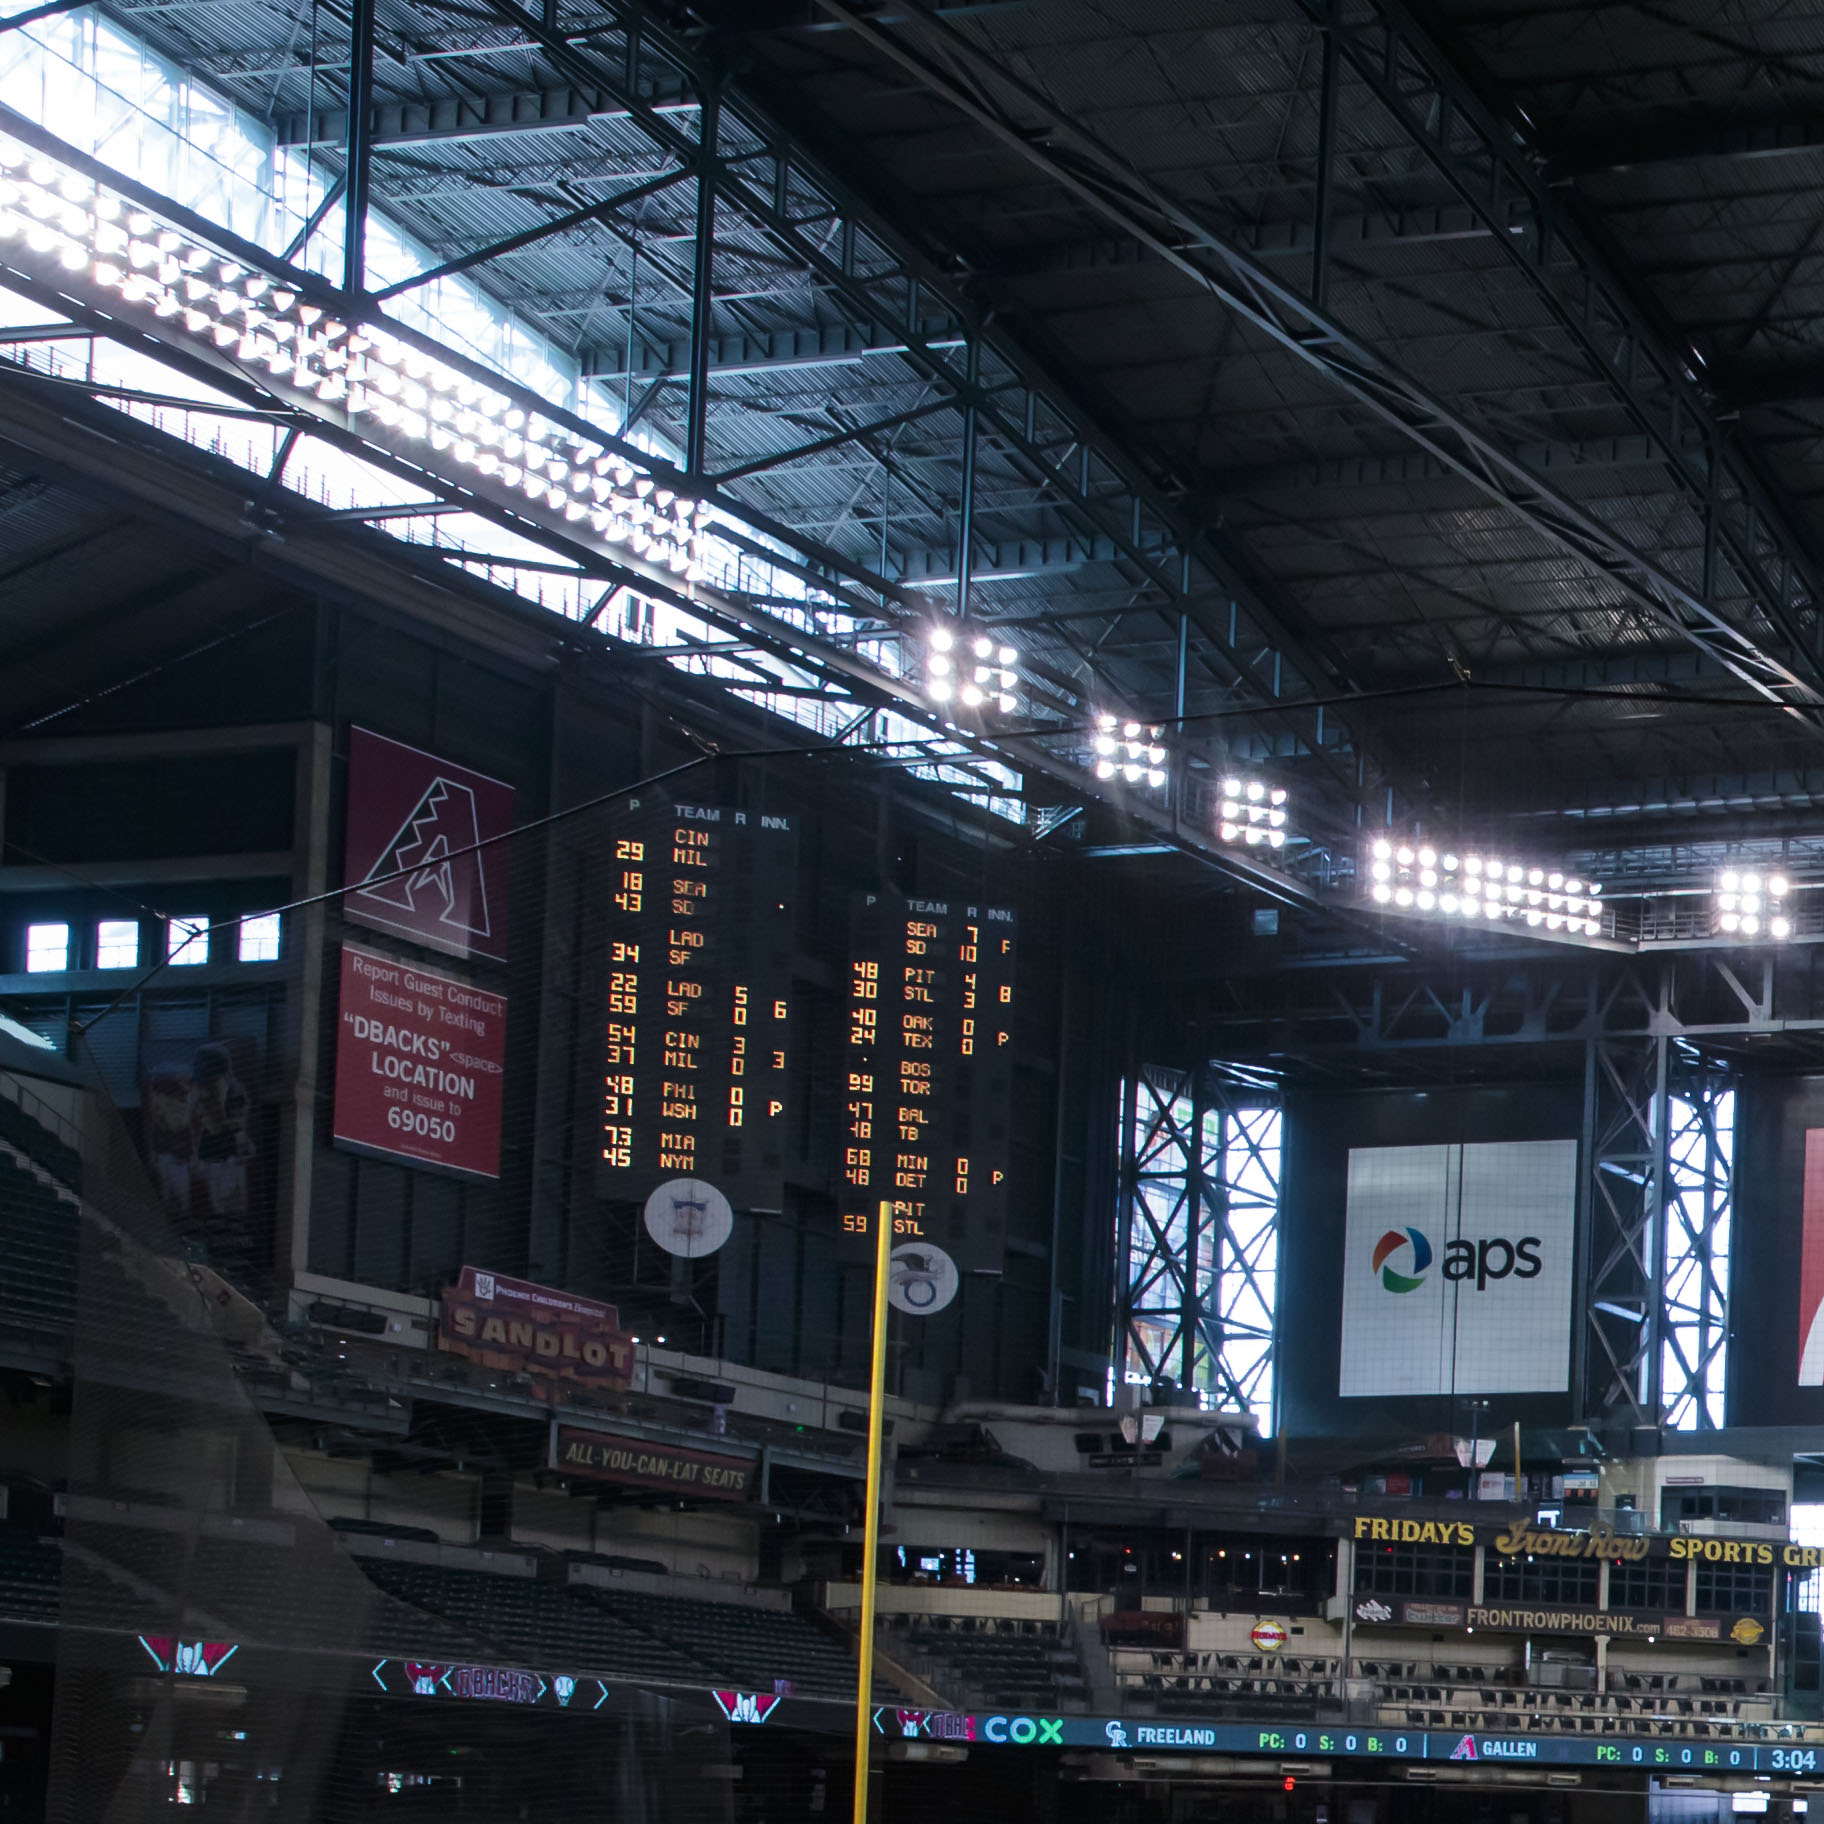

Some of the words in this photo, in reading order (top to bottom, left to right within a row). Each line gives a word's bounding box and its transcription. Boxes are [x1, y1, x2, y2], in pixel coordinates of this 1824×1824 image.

[675, 829, 709, 847] CIN
[673, 848, 708, 866] MIL
[906, 921, 937, 938] SEA
[904, 967, 936, 984] PIT
[353, 956, 399, 985] Report
[404, 974, 443, 999] Guest
[448, 987, 503, 1017] Conduct
[904, 986, 934, 1003] STL
[370, 985, 413, 1012] Issues
[439, 1007, 485, 1037] Texting
[903, 1014, 933, 1031] OAK
[665, 1031, 700, 1049] CIN
[664, 1050, 698, 1069] MIL
[372, 1052, 475, 1100] LOCATION
[900, 1079, 931, 1096] TOR
[384, 1085, 408, 1102] and
[413, 1095, 444, 1112] issue
[388, 1107, 455, 1142] 69050
[661, 1133, 695, 1151] MIA
[659, 1153, 694, 1171] NYM
[896, 1153, 928, 1171] MIN
[895, 1172, 927, 1188] DET
[1442, 1236, 1542, 1291] aps
[453, 1308, 630, 1370] SANDLOT
[704, 1467, 744, 1490] SEATS
[1355, 1516, 1474, 1546] FRIDAY'S
[1669, 1538, 1772, 1565] SPORTS
[1467, 1608, 1660, 1634] FRONTROWPHOENIX.com
[984, 1716, 1064, 1744] COX
[1137, 1727, 1215, 1746] FREELAND
[1482, 1741, 1537, 1758] GALLEN
[1772, 1749, 1816, 1770] 3:04
